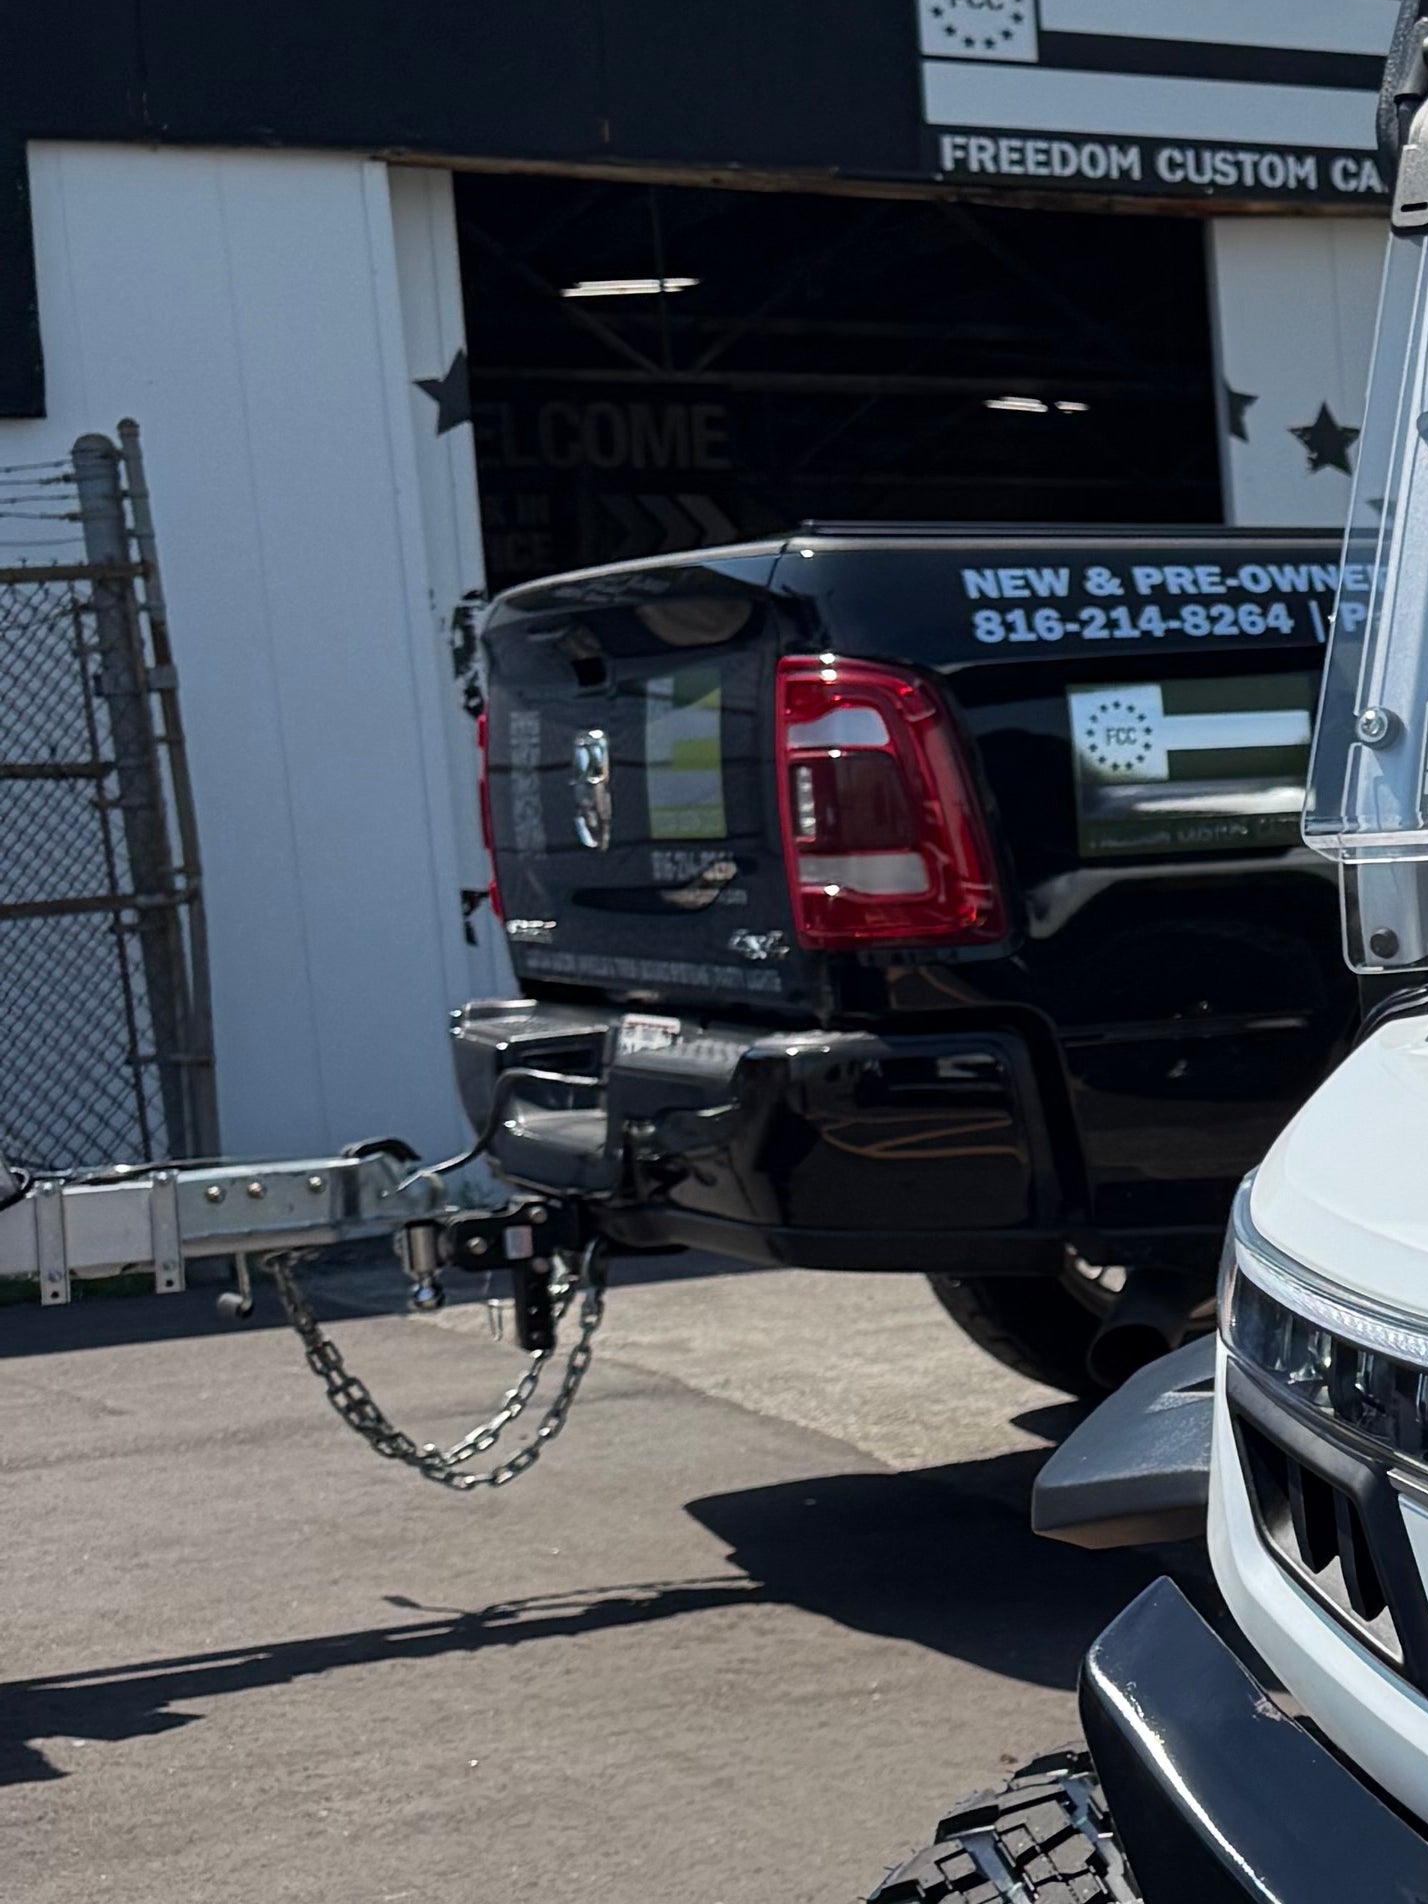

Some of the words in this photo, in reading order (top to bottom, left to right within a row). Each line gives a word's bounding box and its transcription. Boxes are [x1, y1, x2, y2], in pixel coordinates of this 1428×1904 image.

[939, 134, 1142, 182] FREEDOM
[1155, 146, 1319, 191] CUSTOM
[1331, 156, 1389, 194] CA
[475, 399, 733, 471] ELCOME
[961, 565, 1070, 599] NEW
[1083, 567, 1124, 597] &
[972, 601, 1295, 643] 816-214-8264
[1104, 725, 1138, 747] FCC
